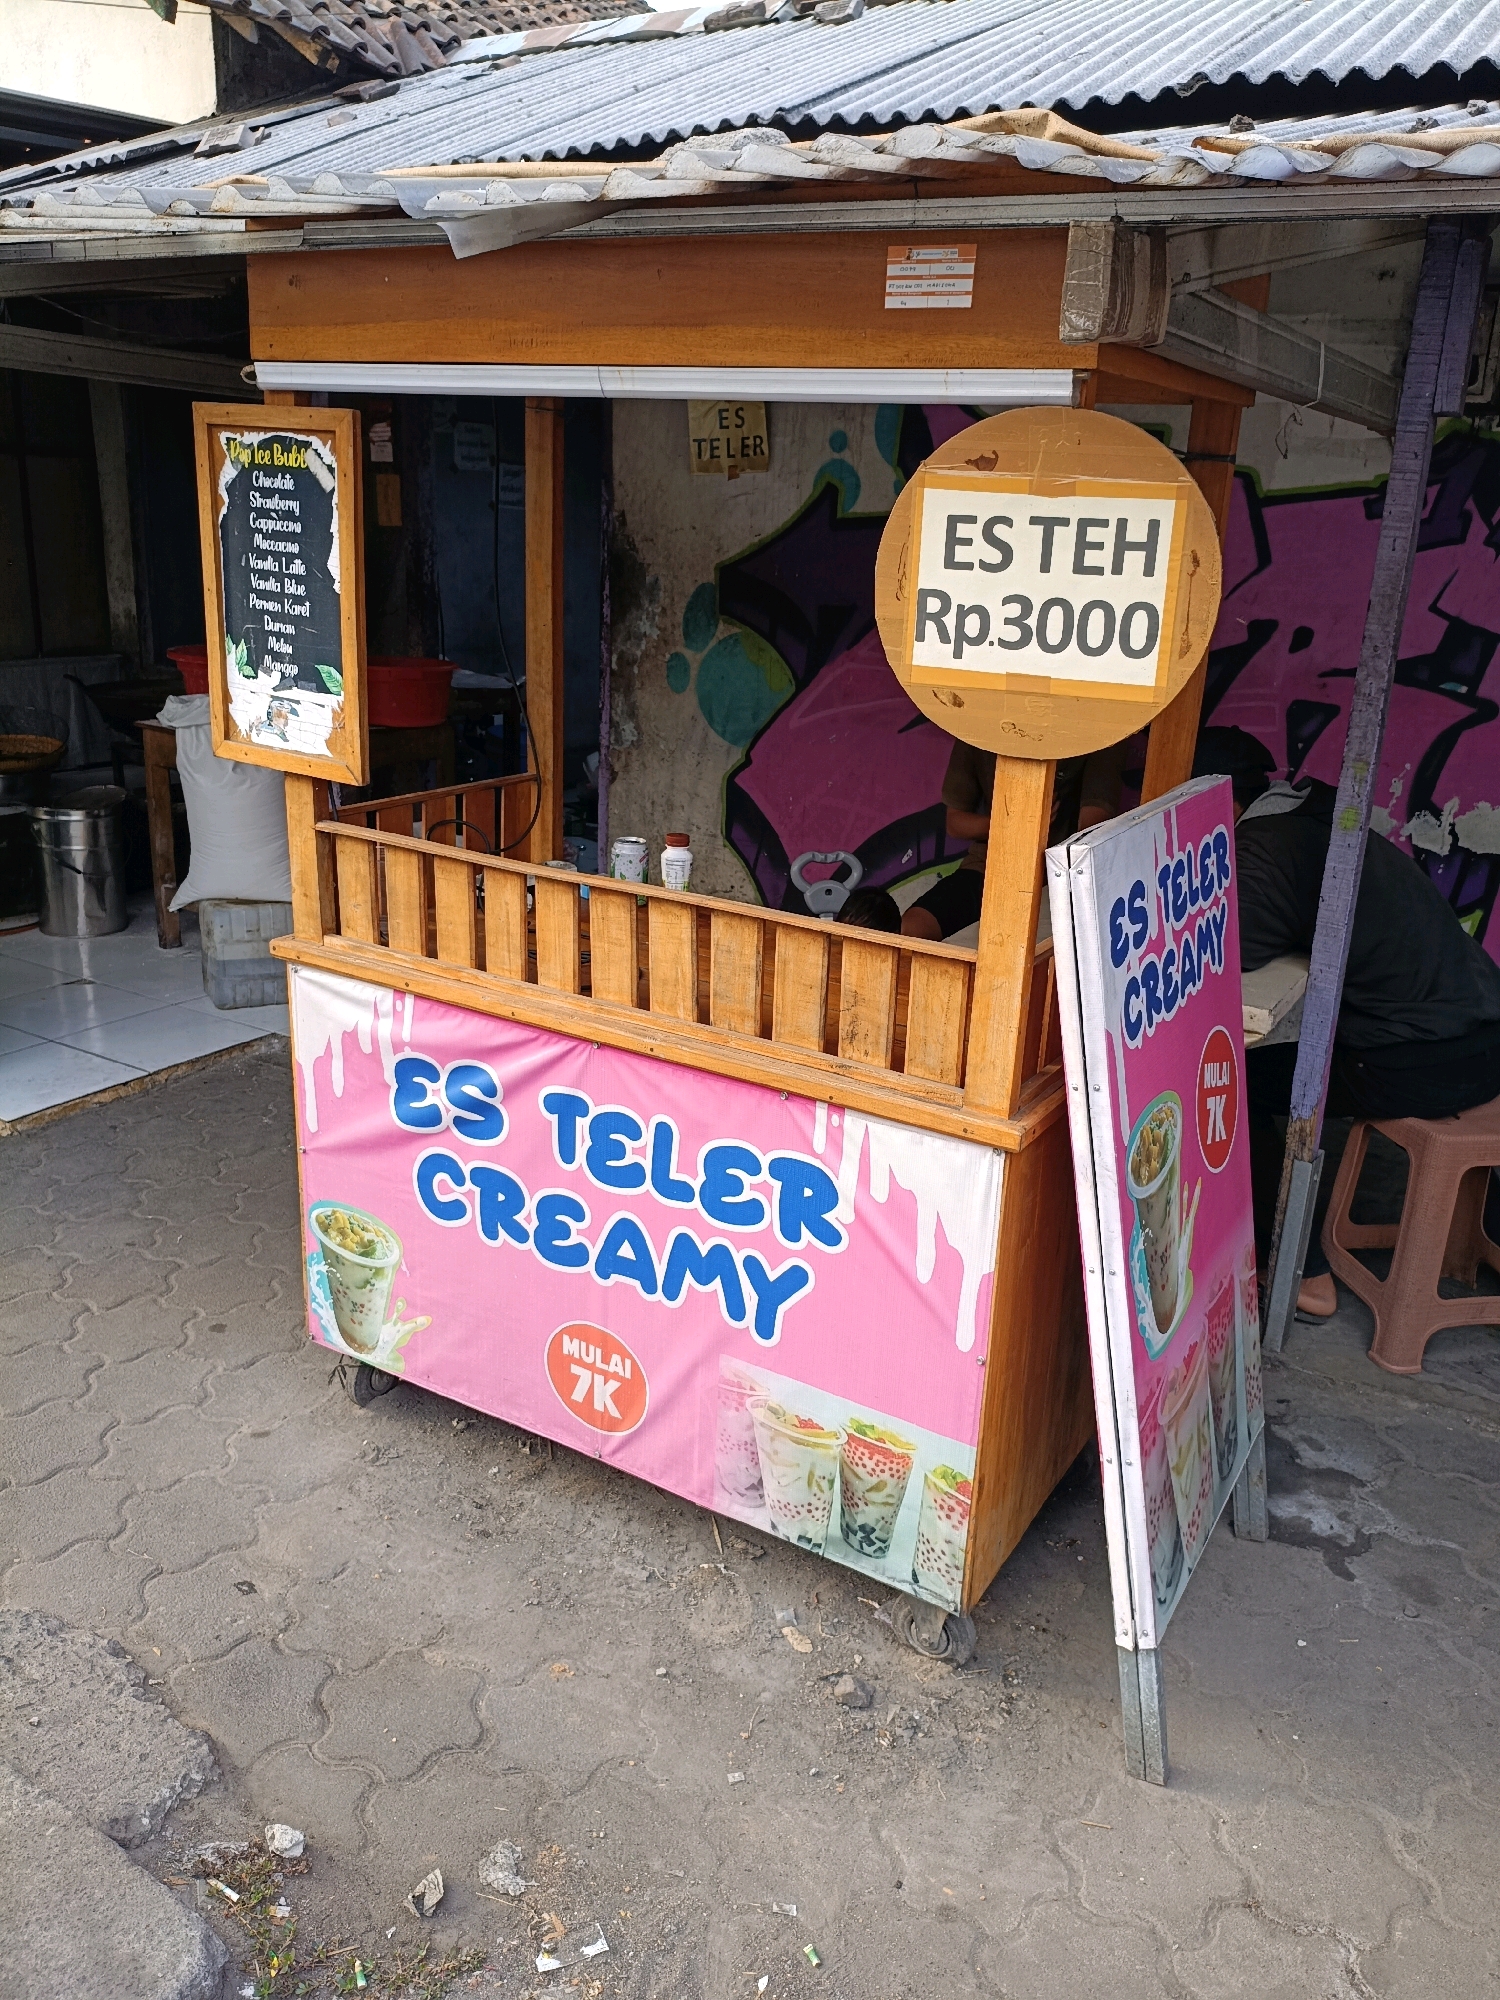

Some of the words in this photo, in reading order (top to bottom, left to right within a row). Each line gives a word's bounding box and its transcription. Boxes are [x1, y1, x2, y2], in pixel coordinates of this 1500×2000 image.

[718, 407, 745, 429] ES
[230, 440, 251, 469] Pop
[254, 443, 272, 465] Ice
[692, 435, 765, 459] TELER
[252, 470, 295, 490] Chocolate
[249, 490, 300, 516] Strawberry
[249, 511, 302, 534] Cappuccino
[943, 514, 1014, 573] ES
[1029, 516, 1160, 577] TEH
[248, 552, 279, 572] Vanilla
[282, 556, 307, 576] Latte
[250, 572, 281, 593] Vanilla
[284, 577, 307, 596] Blue
[249, 592, 282, 613] Permen
[284, 598, 311, 617] Karet
[264, 614, 296, 635] Durian
[915, 588, 1160, 660] Rp.3000
[267, 635, 293, 655] Melon
[1109, 879, 1149, 969] ES
[1157, 830, 1230, 924] TELER
[1123, 903, 1227, 1042] CREAMY
[1203, 1061, 1230, 1089] MULAI
[1206, 1094, 1227, 1145] 7K
[393, 1057, 507, 1141] ES
[543, 1092, 843, 1247] TELER
[416, 1152, 810, 1341] CREAMY
[562, 1333, 632, 1380] MULAI
[570, 1363, 623, 1420] 7K
